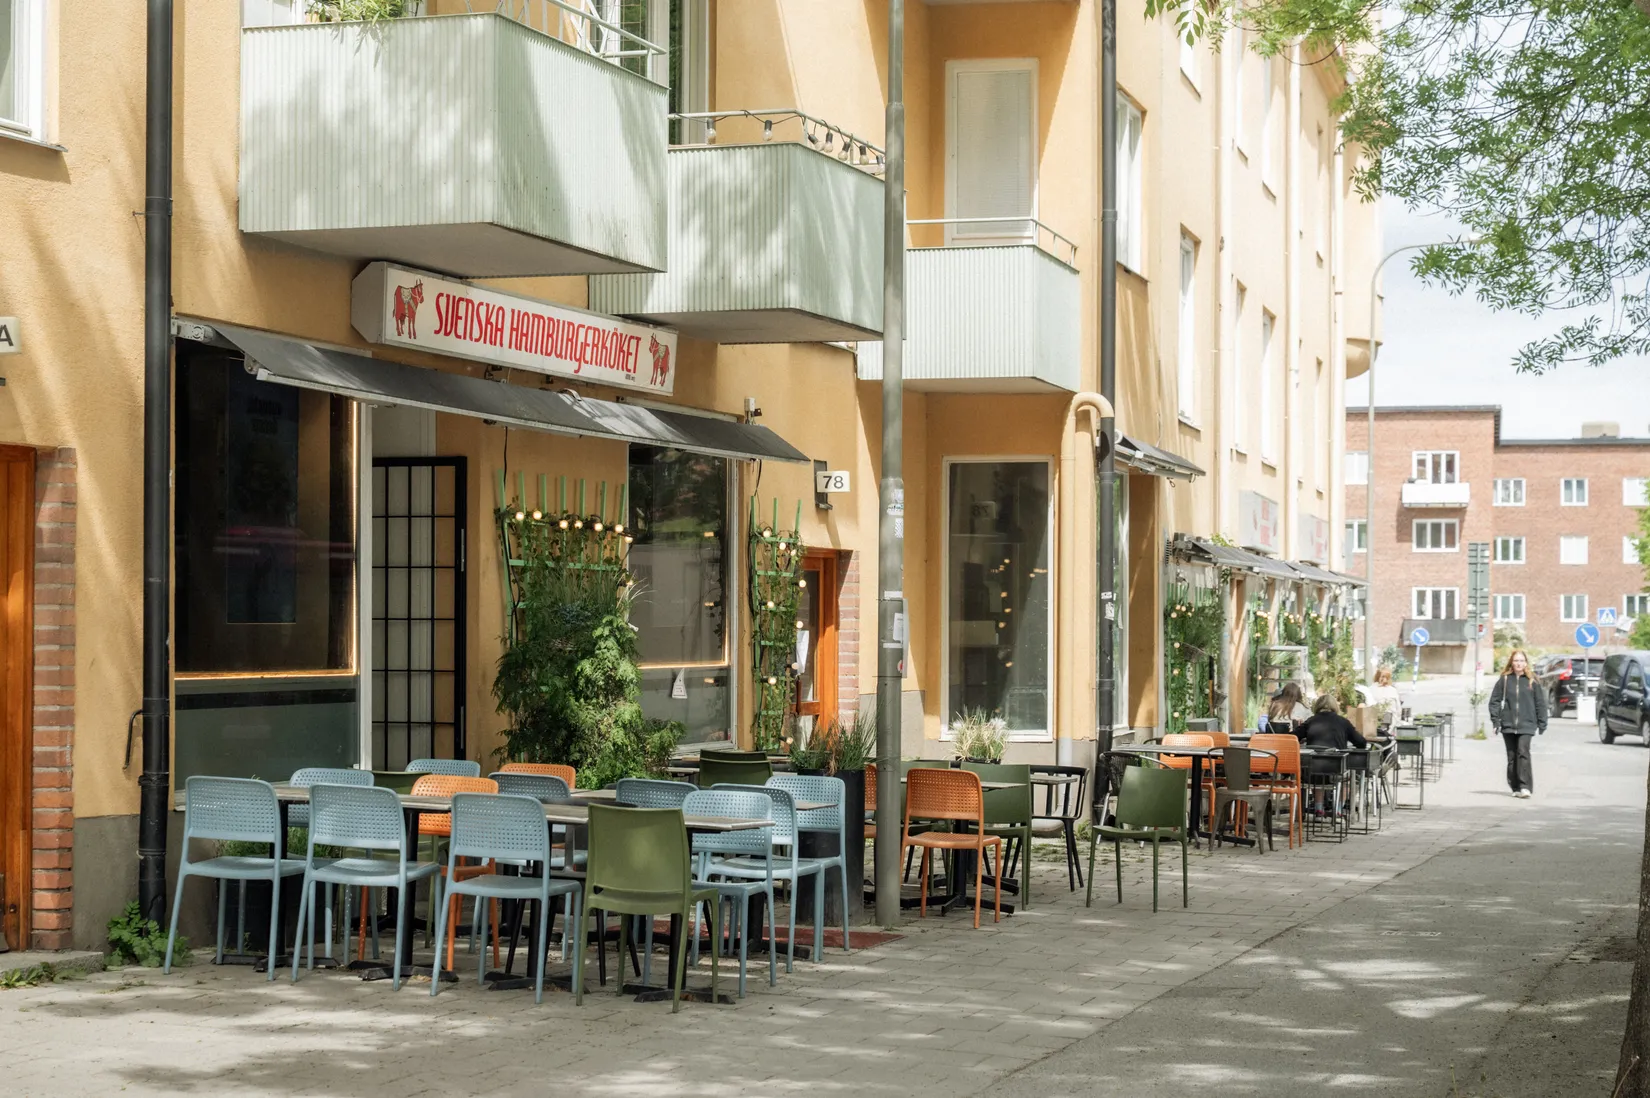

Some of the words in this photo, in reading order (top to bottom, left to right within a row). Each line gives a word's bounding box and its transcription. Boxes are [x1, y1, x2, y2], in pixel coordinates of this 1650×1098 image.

[434, 292, 505, 348] SVENSKA
[508, 308, 642, 374] HAMBURGERKÖKET
[823, 475, 844, 489] 78
